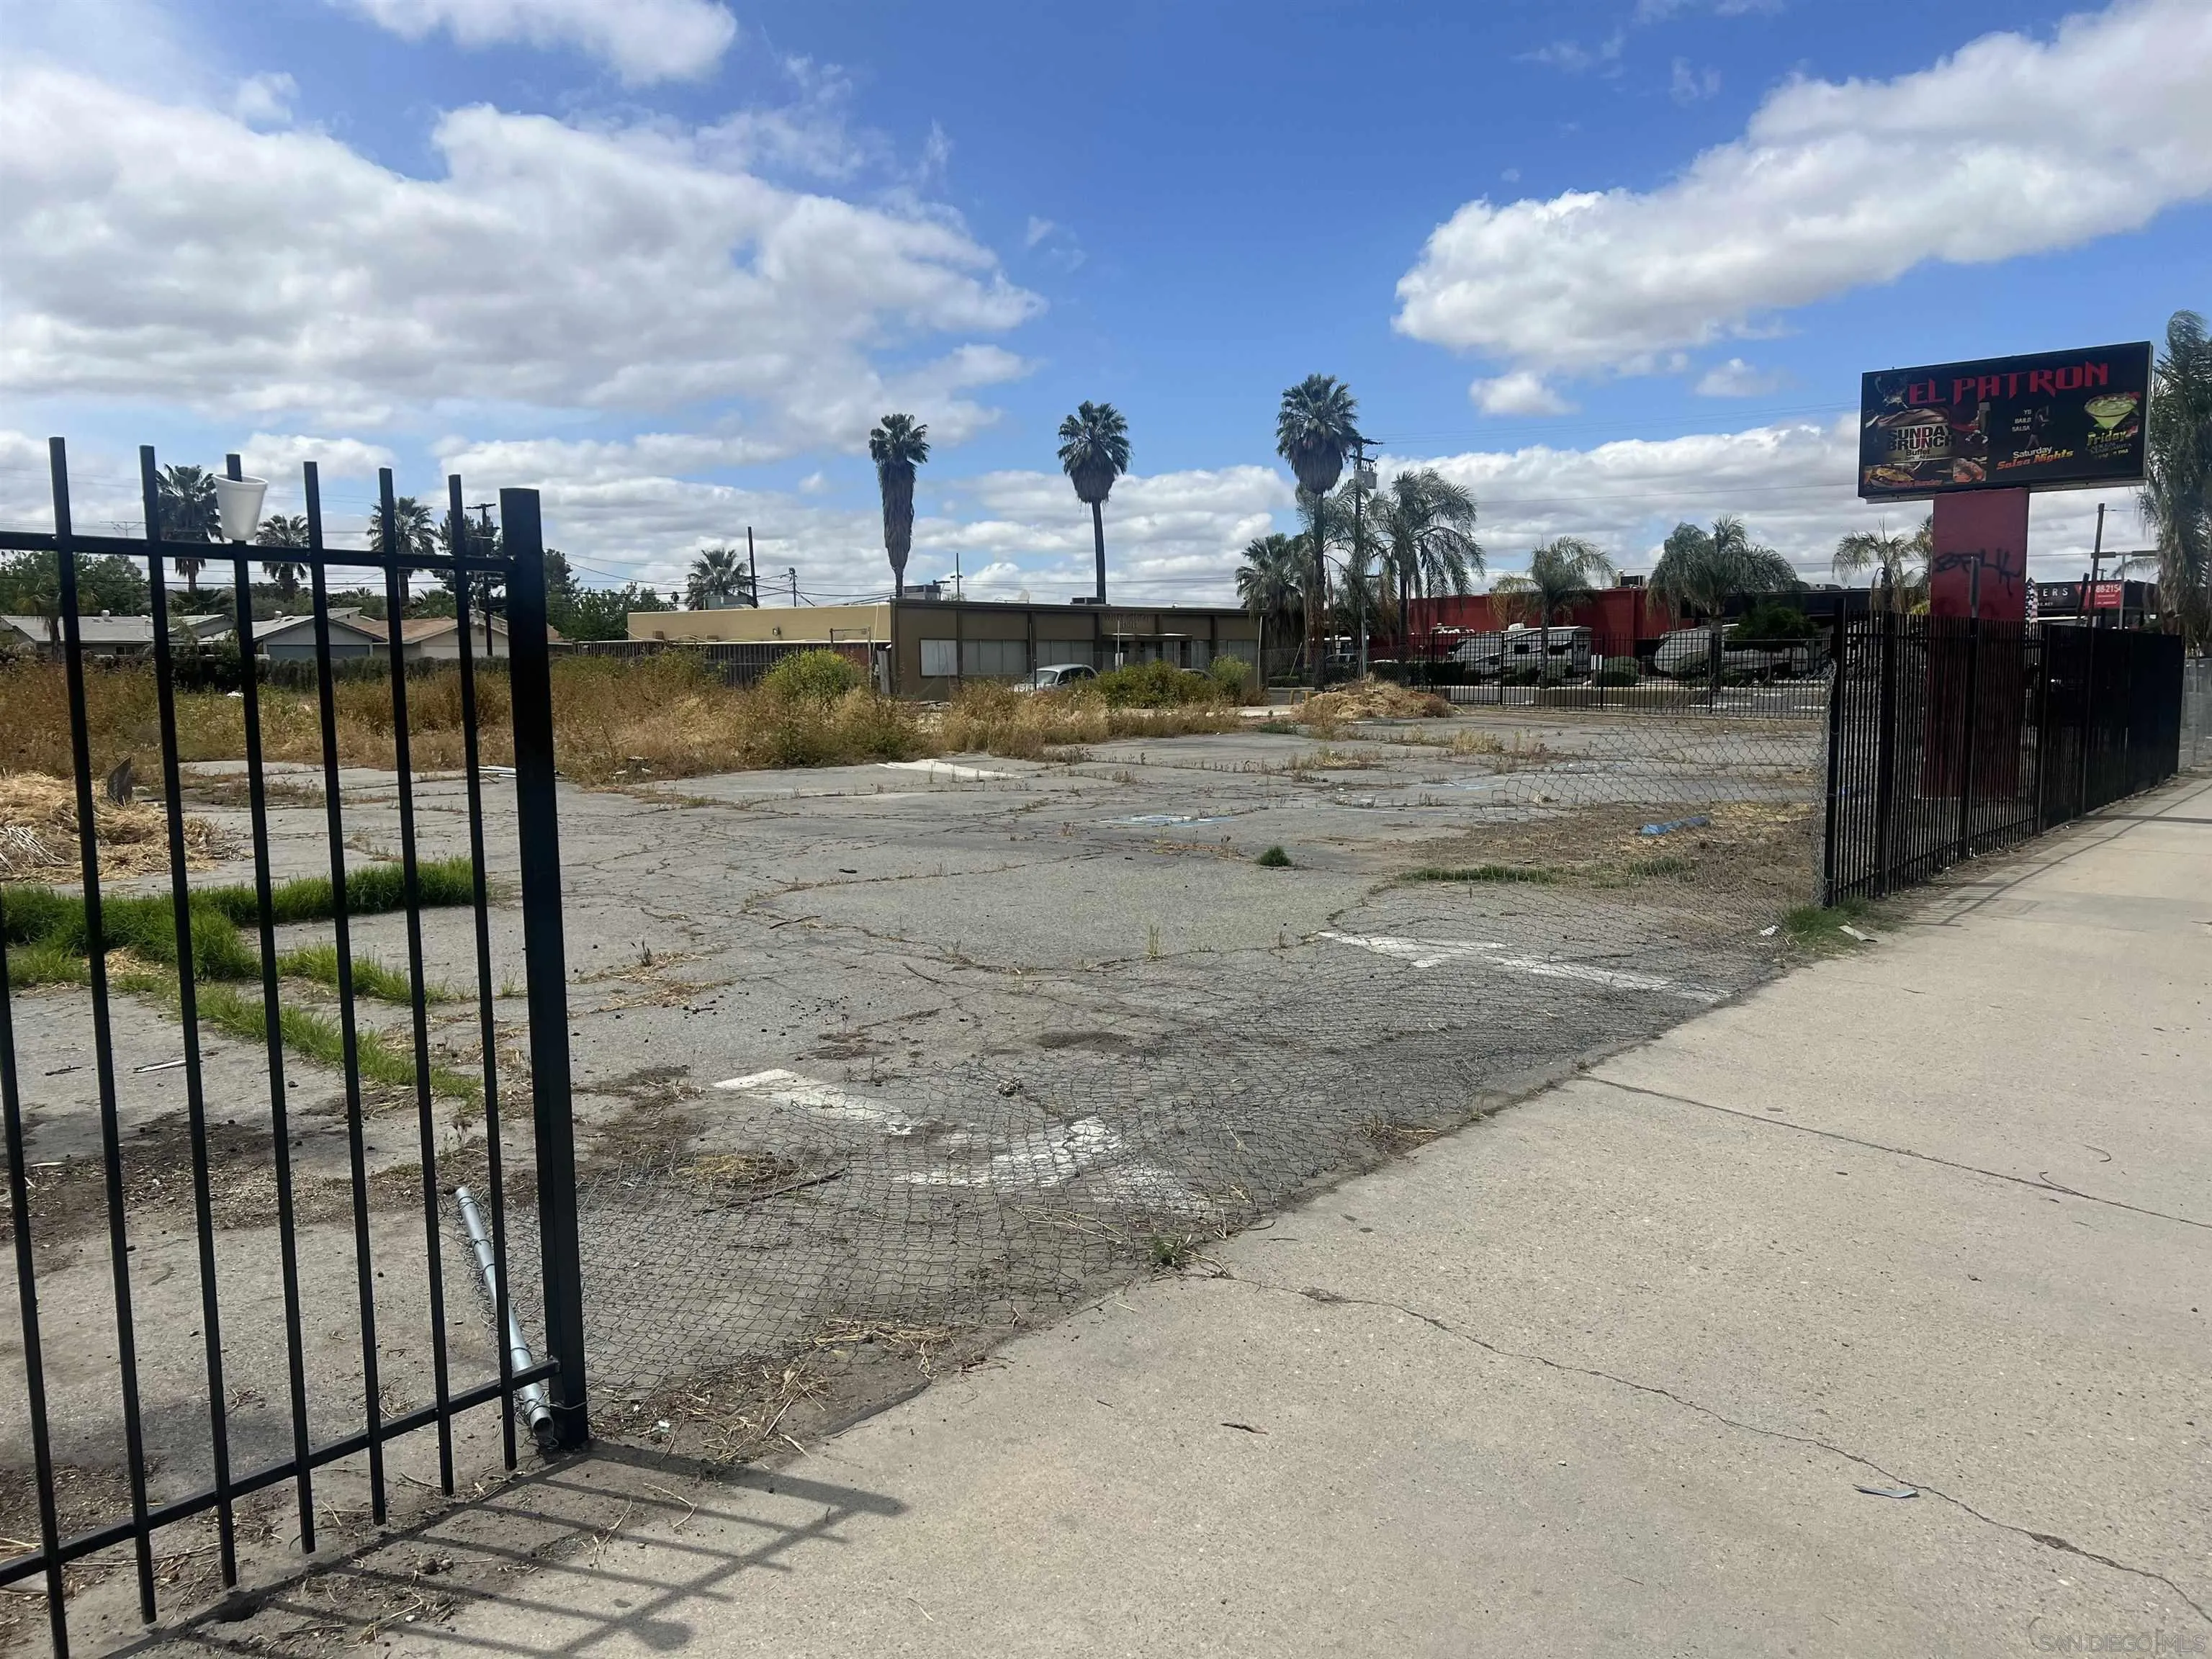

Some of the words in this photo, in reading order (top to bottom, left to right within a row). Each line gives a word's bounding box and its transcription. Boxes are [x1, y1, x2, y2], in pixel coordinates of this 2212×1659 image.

[1909, 377, 1946, 405] EL
[1953, 361, 2109, 406] PATRON
[1906, 447, 1930, 457] Buffet
[1997, 457, 2031, 470] Salsa
[2033, 449, 2074, 465] Nights
[2013, 446, 2052, 459] Saturday
